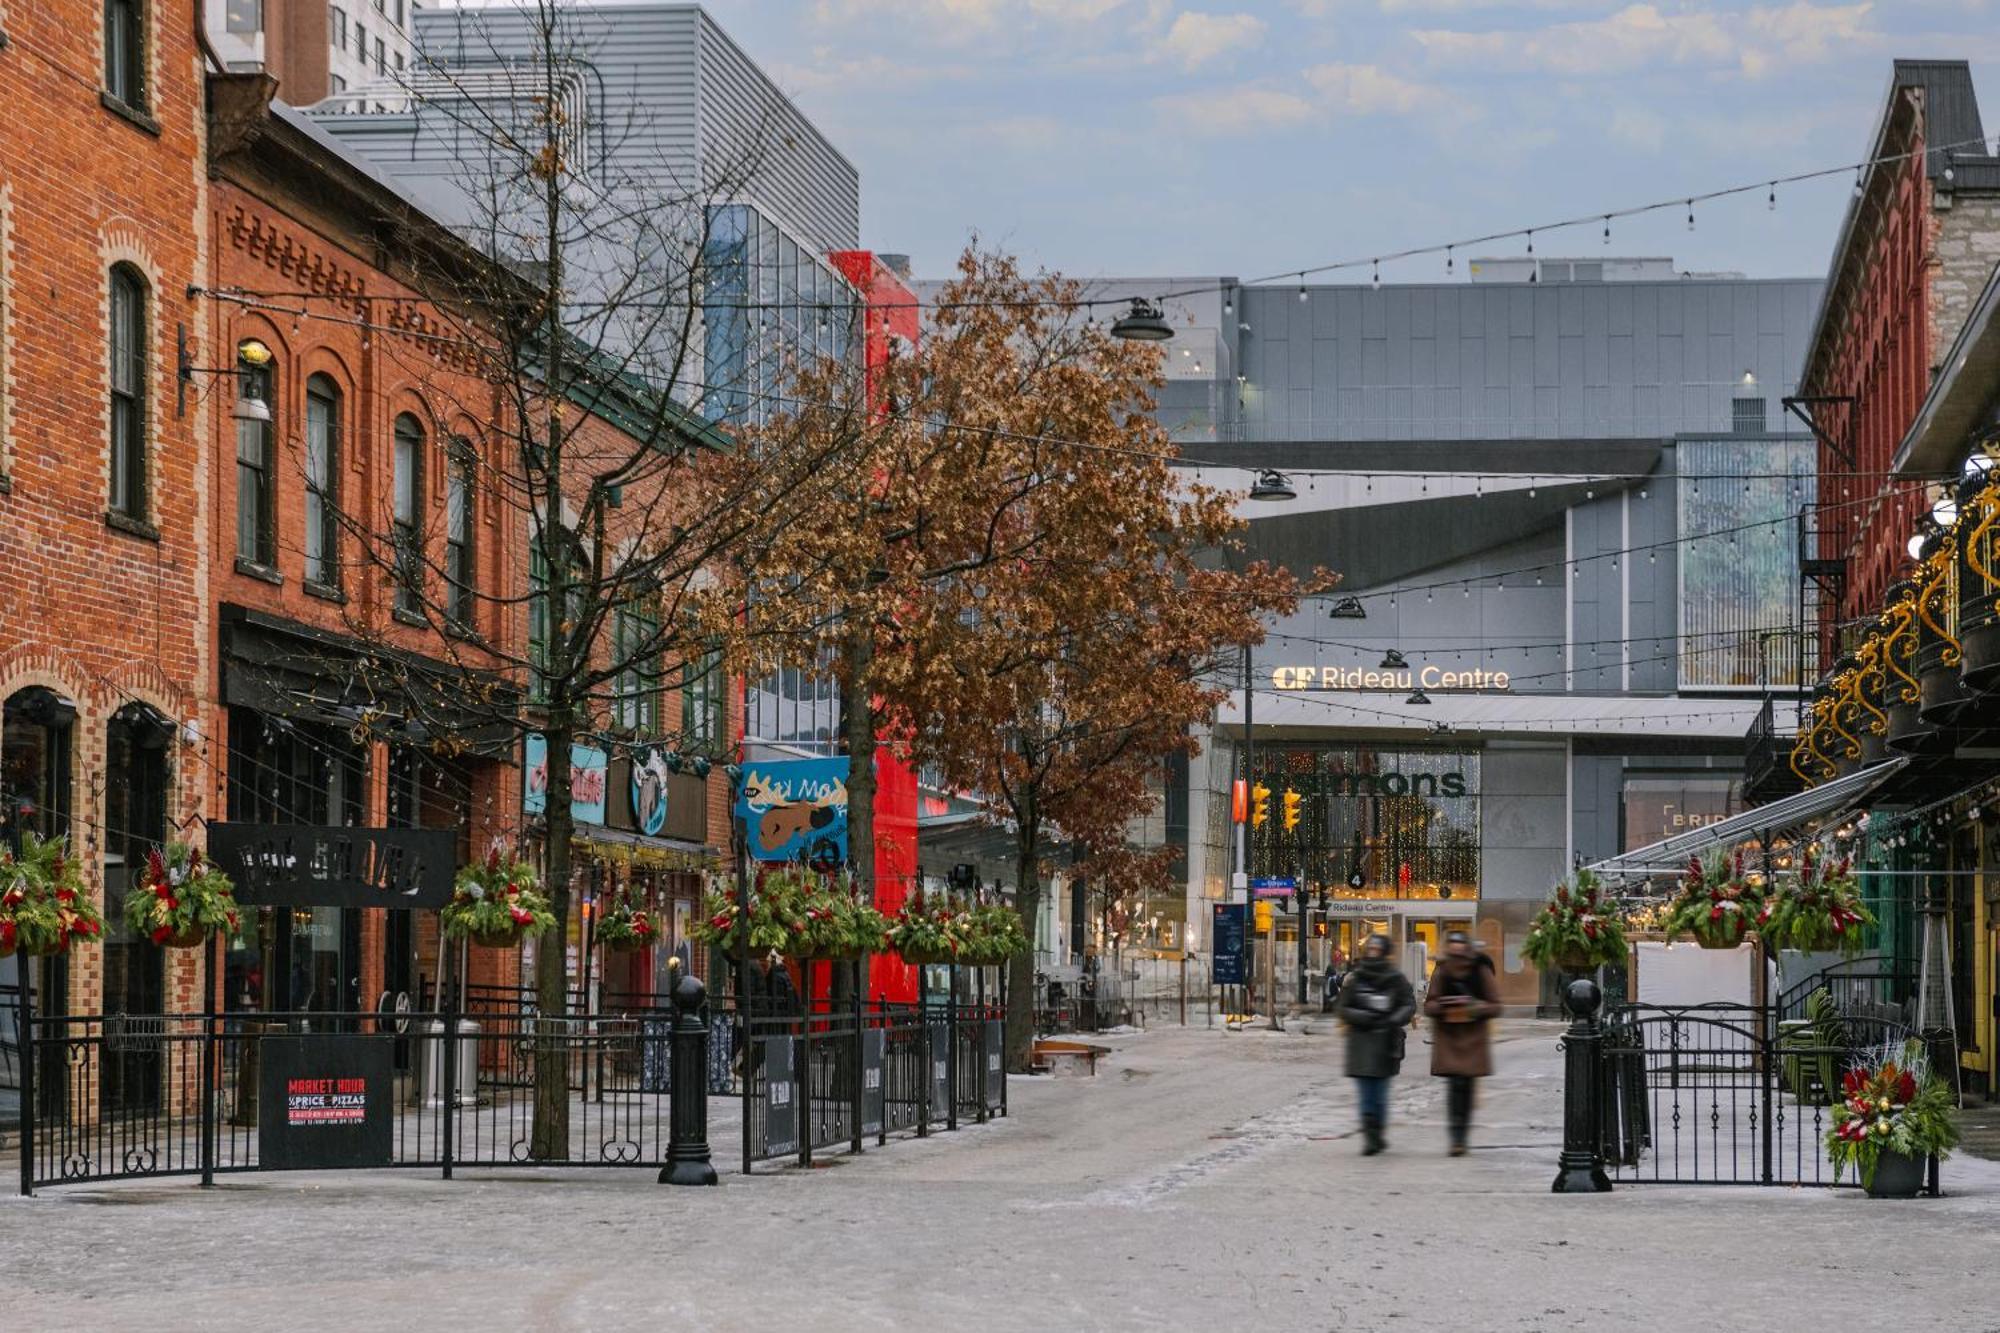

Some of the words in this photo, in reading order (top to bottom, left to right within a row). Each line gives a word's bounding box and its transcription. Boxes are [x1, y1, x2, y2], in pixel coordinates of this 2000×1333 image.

[1273, 667, 1316, 689] CF
[1322, 667, 1411, 689] Rideau
[1420, 666, 1510, 689] Centre
[1333, 903, 1363, 912] Rideau
[288, 1079, 334, 1094] MARKET
[337, 1078, 365, 1093] HOUR
[295, 1096, 325, 1106] PRICE
[332, 1095, 365, 1105] PIZZAS
